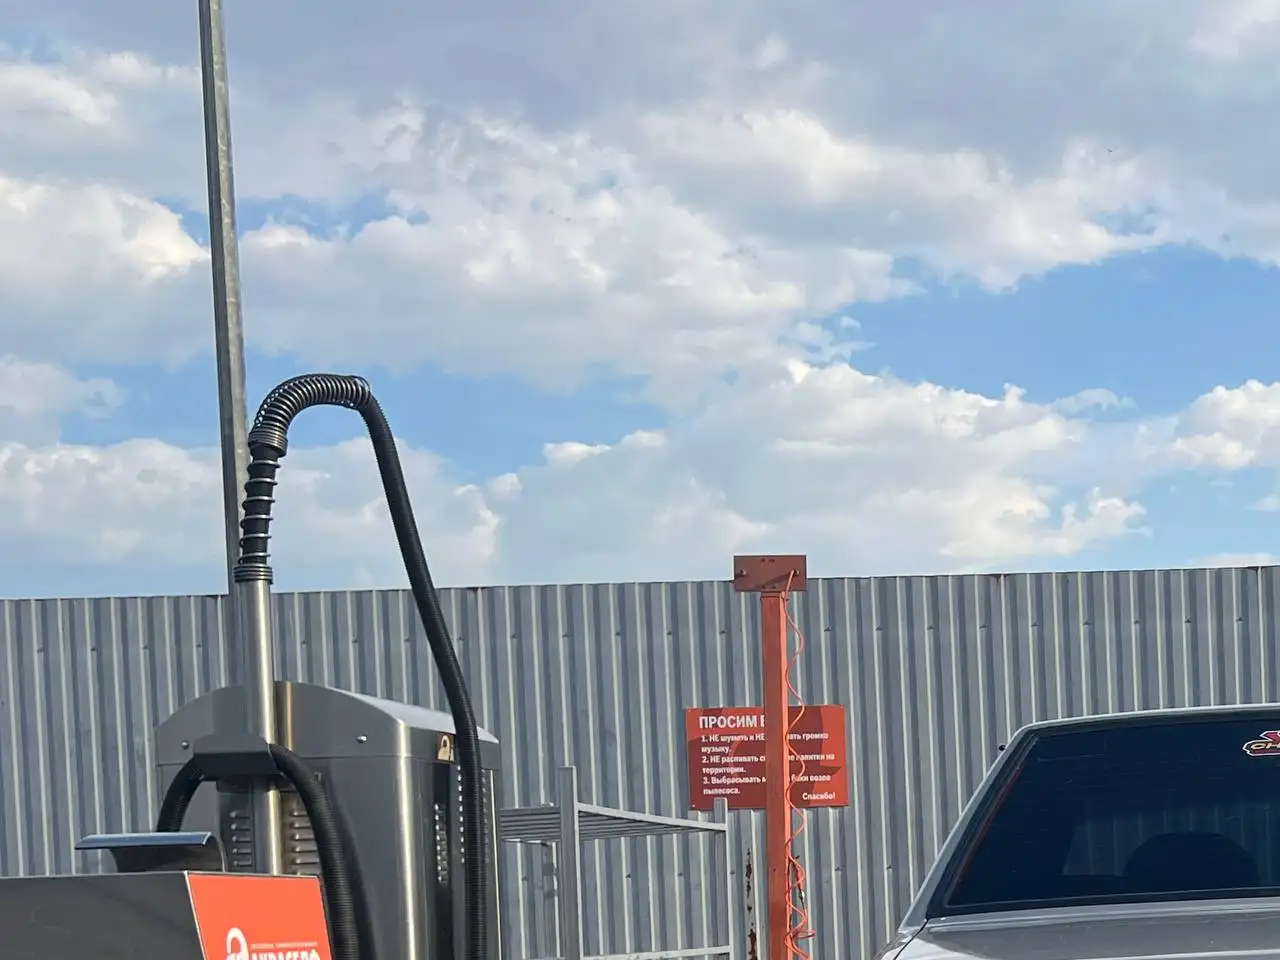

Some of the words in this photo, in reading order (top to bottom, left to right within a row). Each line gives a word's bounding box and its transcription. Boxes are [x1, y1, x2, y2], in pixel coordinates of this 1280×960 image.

[699, 715, 757, 728] ПРОСИМ
[709, 734, 719, 742] НЕ
[755, 733, 765, 741] НЕ
[802, 733, 829, 741] громко
[710, 755, 720, 763] НЕ
[721, 755, 758, 764] распивать
[711, 775, 761, 785] Выбрасывать
[802, 792, 836, 800] Спасибо!
